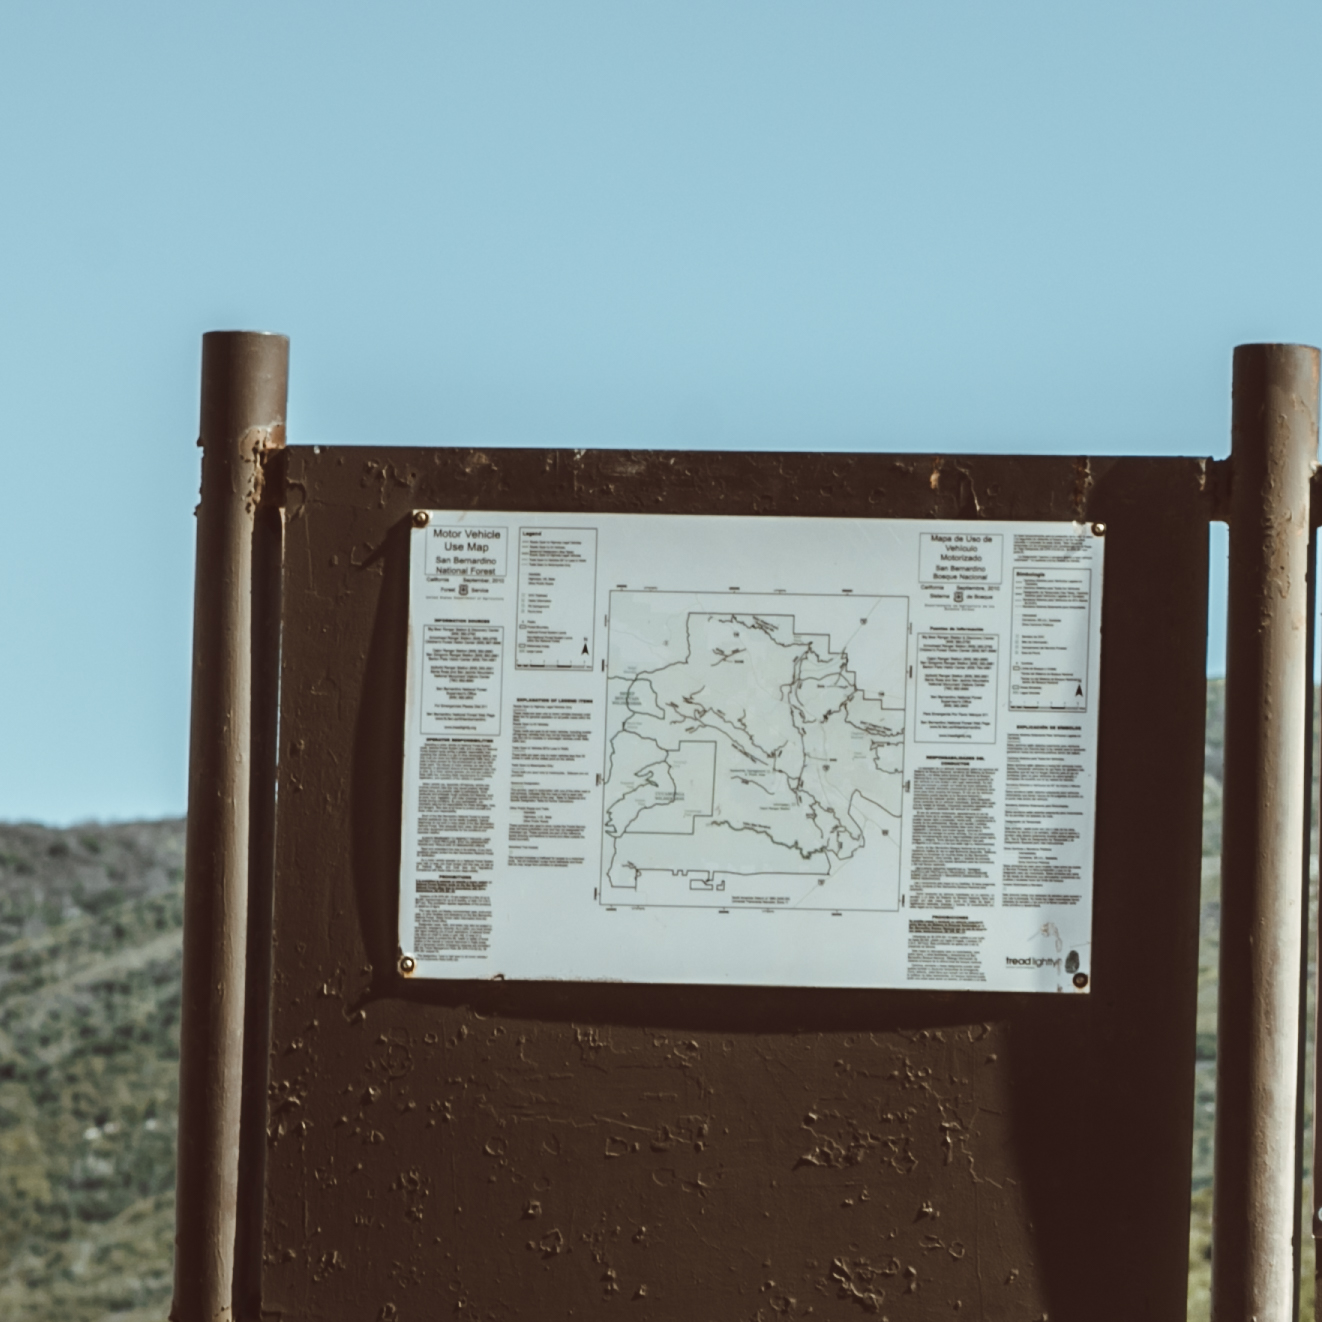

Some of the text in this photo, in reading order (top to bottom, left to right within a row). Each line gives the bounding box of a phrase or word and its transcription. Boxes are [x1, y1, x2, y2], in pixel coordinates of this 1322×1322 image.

[433, 529, 502, 540] Motor Vehicle
[931, 534, 952, 543] Mapa
[966, 535, 981, 543] Uso
[444, 541, 490, 554] Use Map
[435, 556, 497, 566] San Bernardino
[940, 554, 983, 562] Motorizado
[436, 566, 496, 576] National Forest
[935, 564, 986, 573] San Bernardino
[933, 573, 958, 581] Bosque
